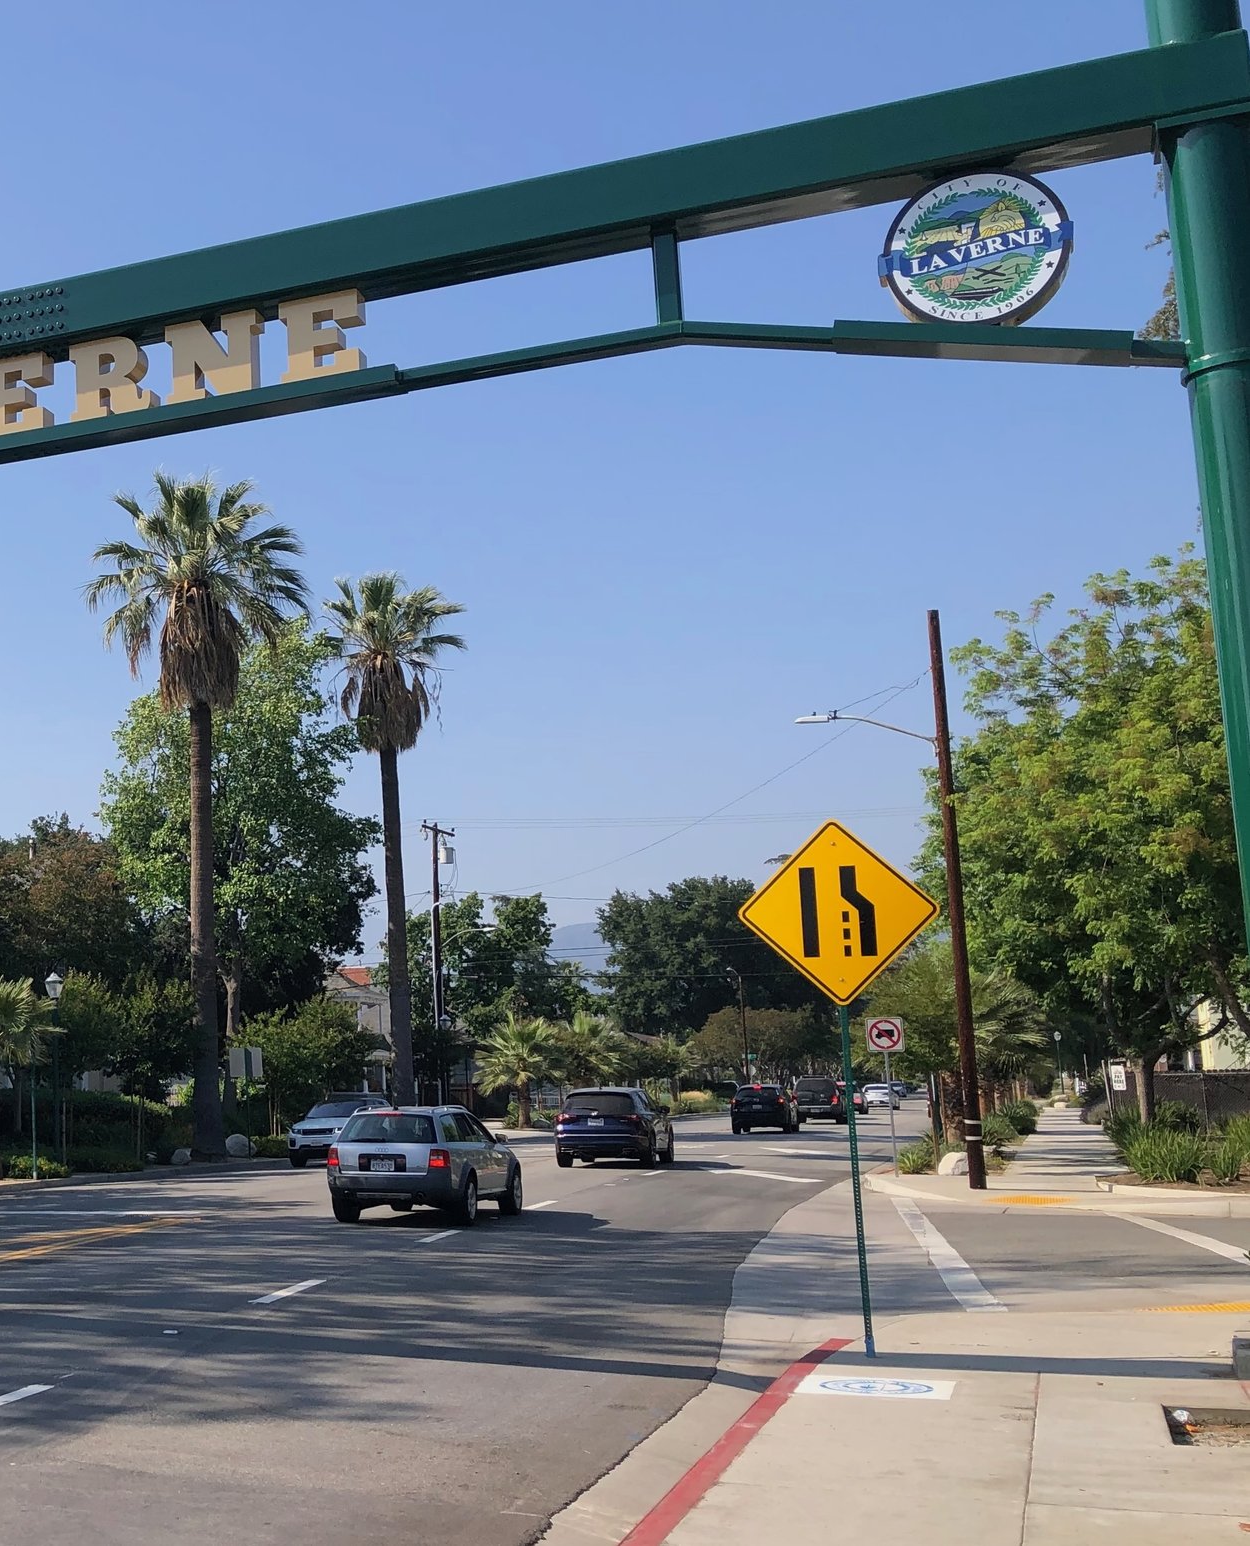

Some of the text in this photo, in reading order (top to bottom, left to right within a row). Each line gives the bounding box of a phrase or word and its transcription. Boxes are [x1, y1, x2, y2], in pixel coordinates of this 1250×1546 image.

[917, 178, 1024, 210] CITY OF
[909, 228, 1046, 275] LA VERNE
[929, 287, 1034, 321] SINCE 1906
